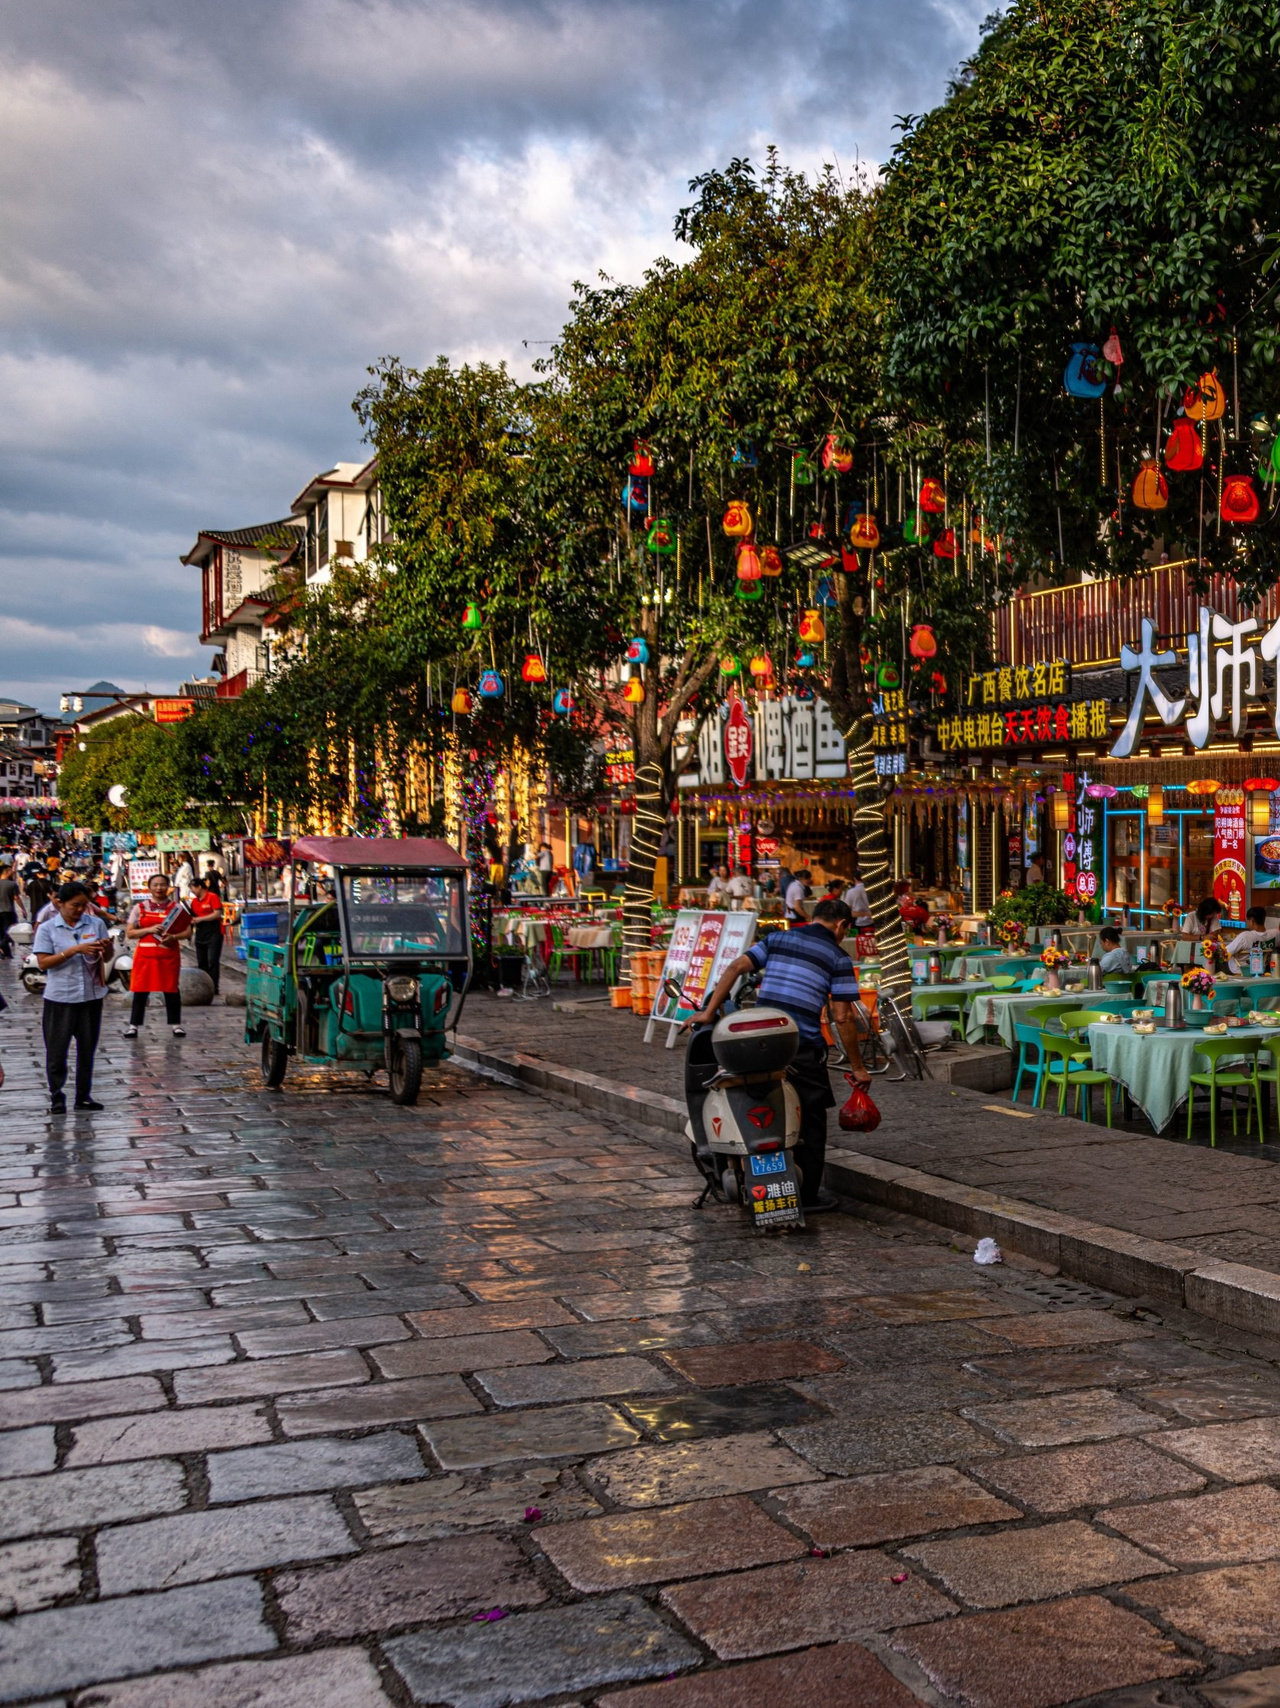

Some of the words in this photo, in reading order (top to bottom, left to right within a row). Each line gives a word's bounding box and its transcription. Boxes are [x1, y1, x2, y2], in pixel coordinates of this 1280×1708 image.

[967, 659, 1065, 706] 广西餐饮名店
[754, 696, 847, 781] 啤酒鱼
[937, 699, 1107, 750] 中央电视台天天饮食播报
[1077, 771, 1094, 870] 大师傅
[1222, 839, 1238, 849] 第一名
[757, 842, 776, 850] LOVE
[767, 1180, 796, 1198] 雅迪
